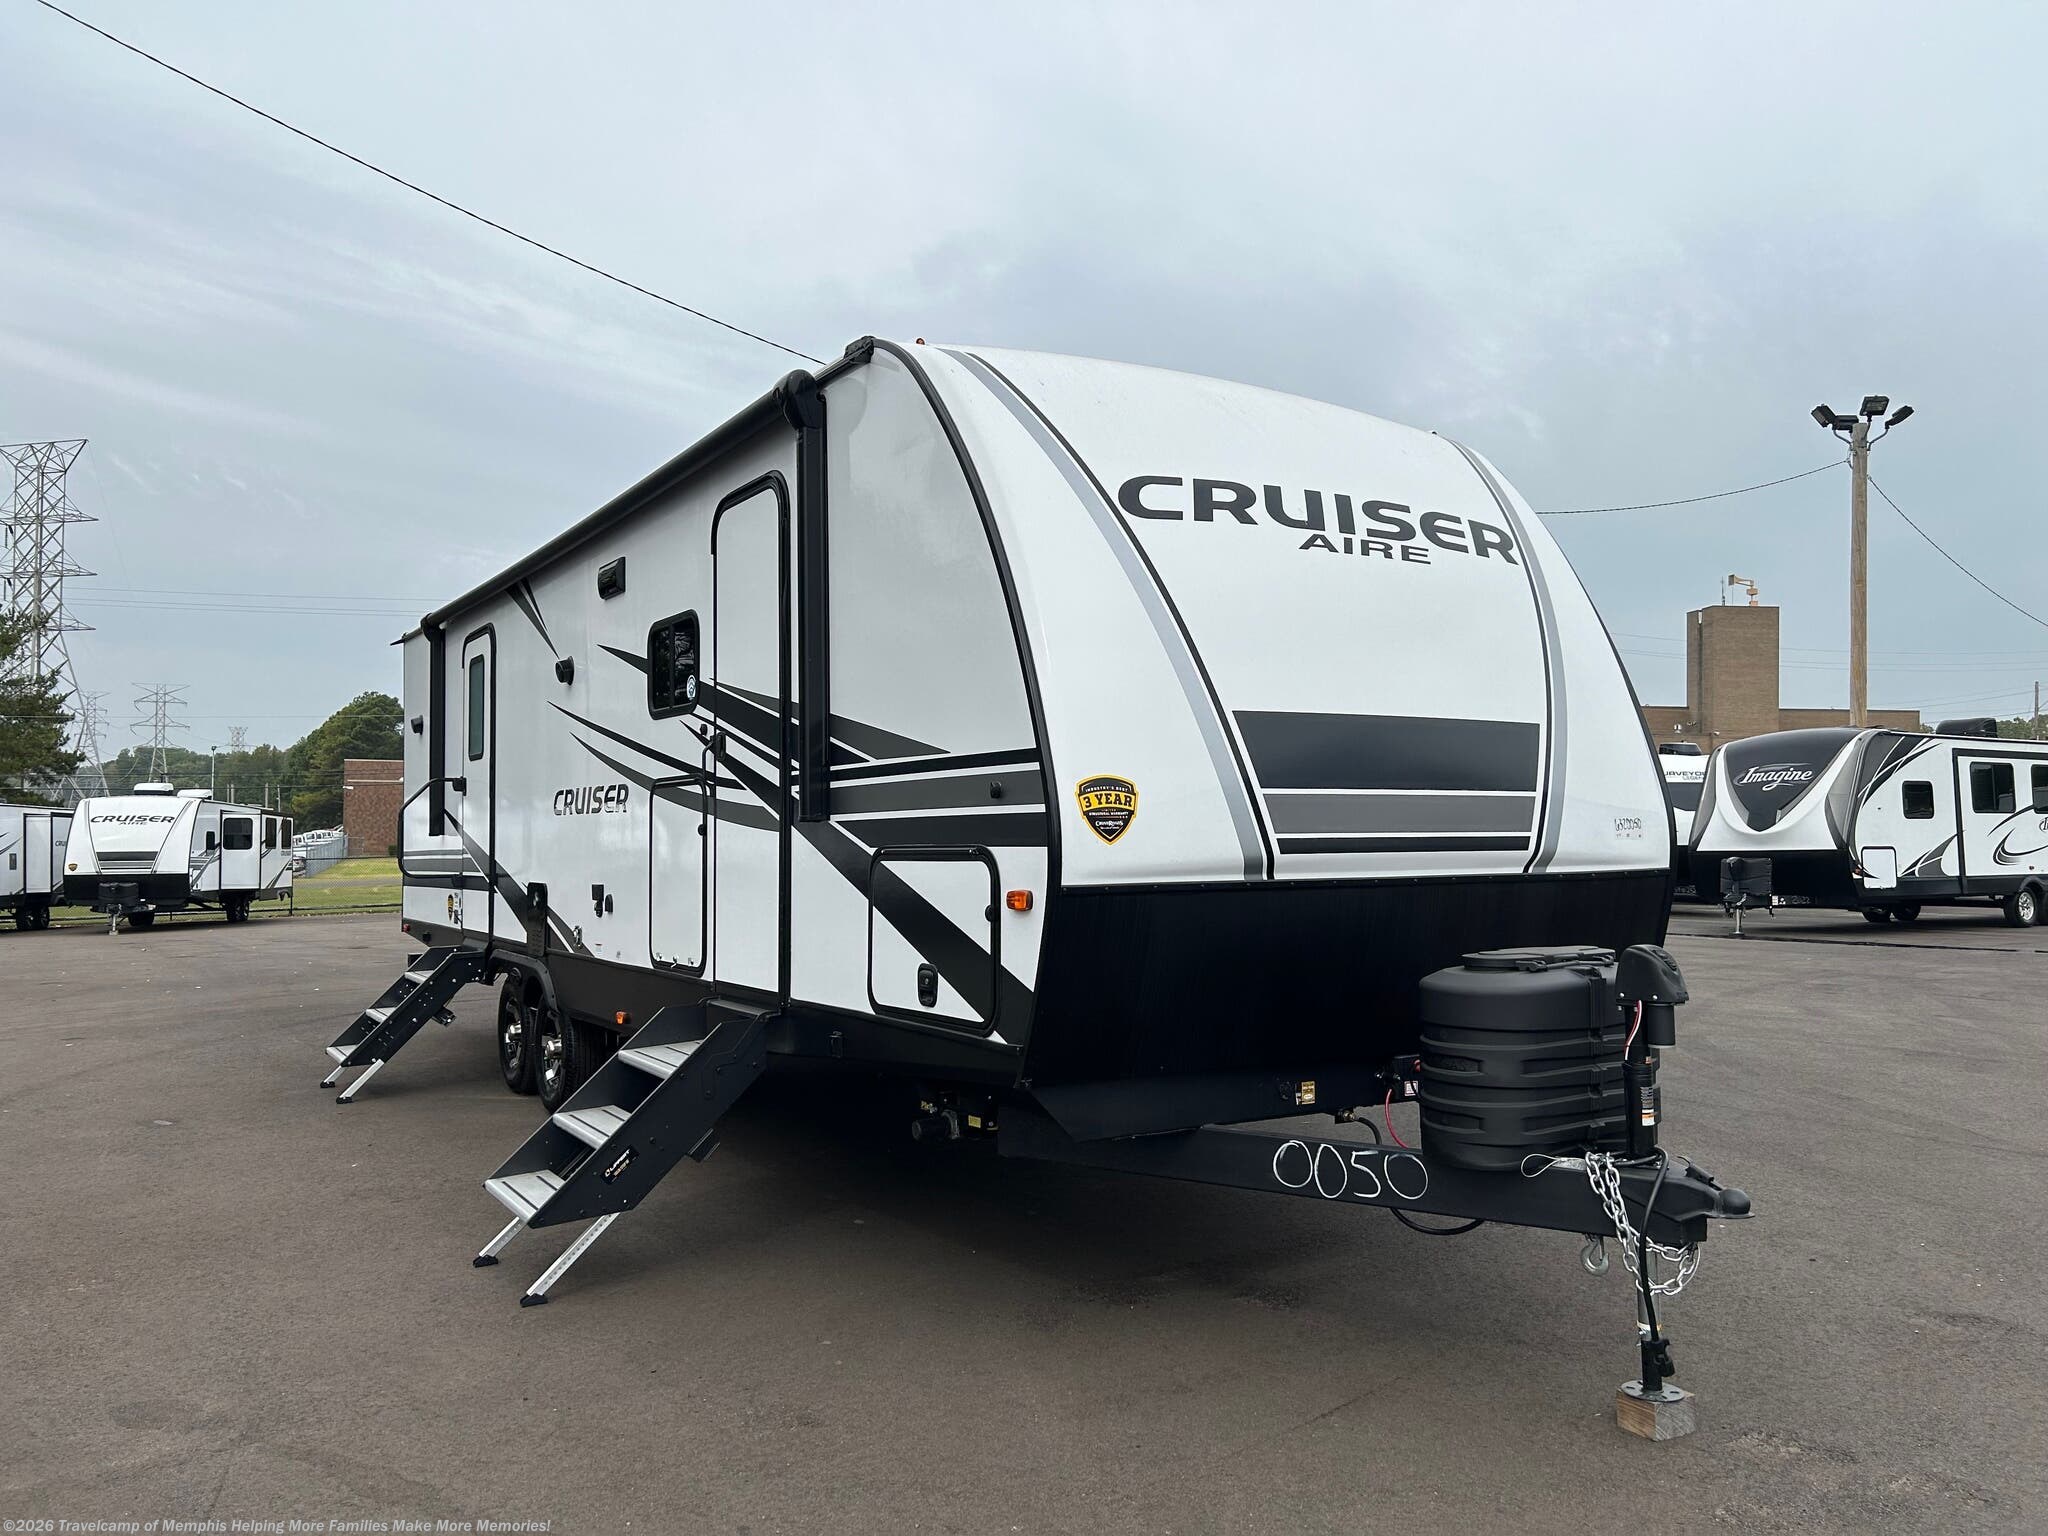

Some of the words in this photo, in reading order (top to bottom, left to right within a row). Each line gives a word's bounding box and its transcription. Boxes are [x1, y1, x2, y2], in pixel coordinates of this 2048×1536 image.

[1117, 475, 1519, 566] CRUISER
[1297, 532, 1432, 565] AIRE
[1740, 766, 1813, 791] Imagine
[553, 783, 629, 816] CRUISER
[1083, 796, 1092, 808] 3
[1094, 793, 1132, 807] YEAR
[90, 815, 176, 823] CRUISER
[1272, 1139, 1429, 1200] 0050
